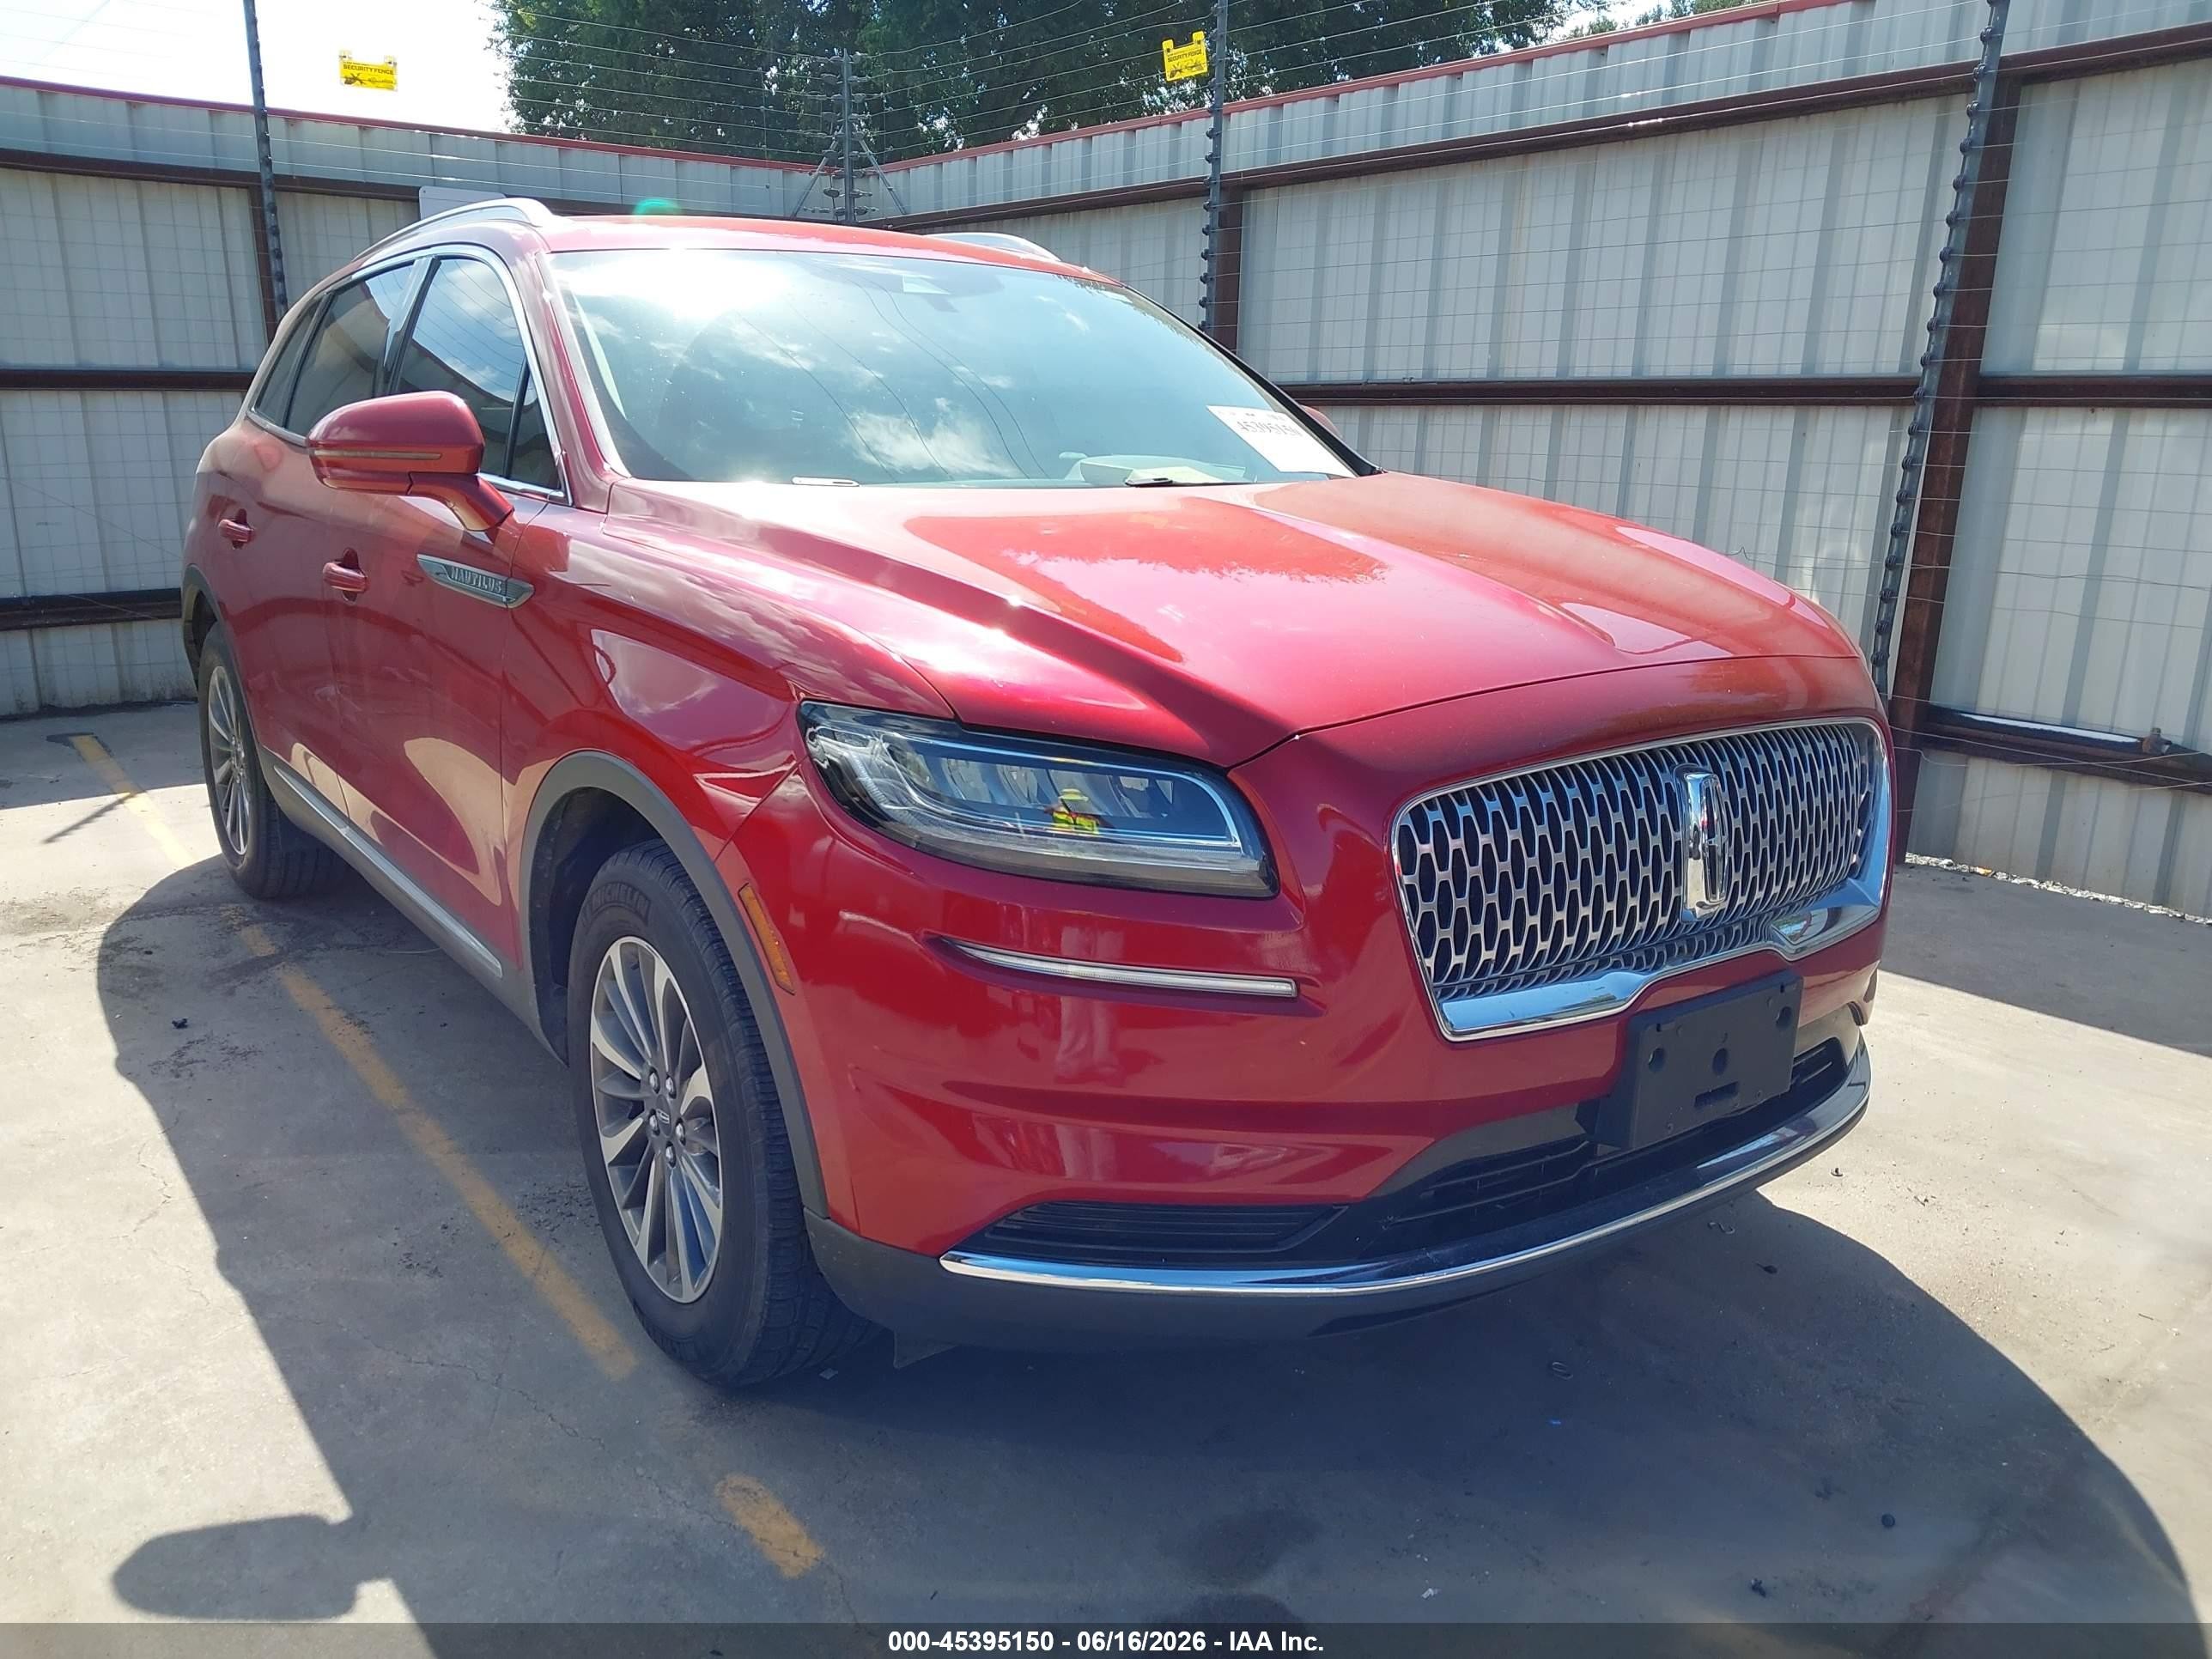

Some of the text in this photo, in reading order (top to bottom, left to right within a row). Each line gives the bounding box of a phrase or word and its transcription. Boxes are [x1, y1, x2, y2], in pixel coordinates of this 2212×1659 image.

[1167, 53, 1188, 63] SECURITY
[1188, 49, 1202, 58] FENCE
[343, 64, 373, 73] SECURITY
[450, 566, 502, 593] NAUTILUS
[592, 883, 649, 916] MICHELIN
